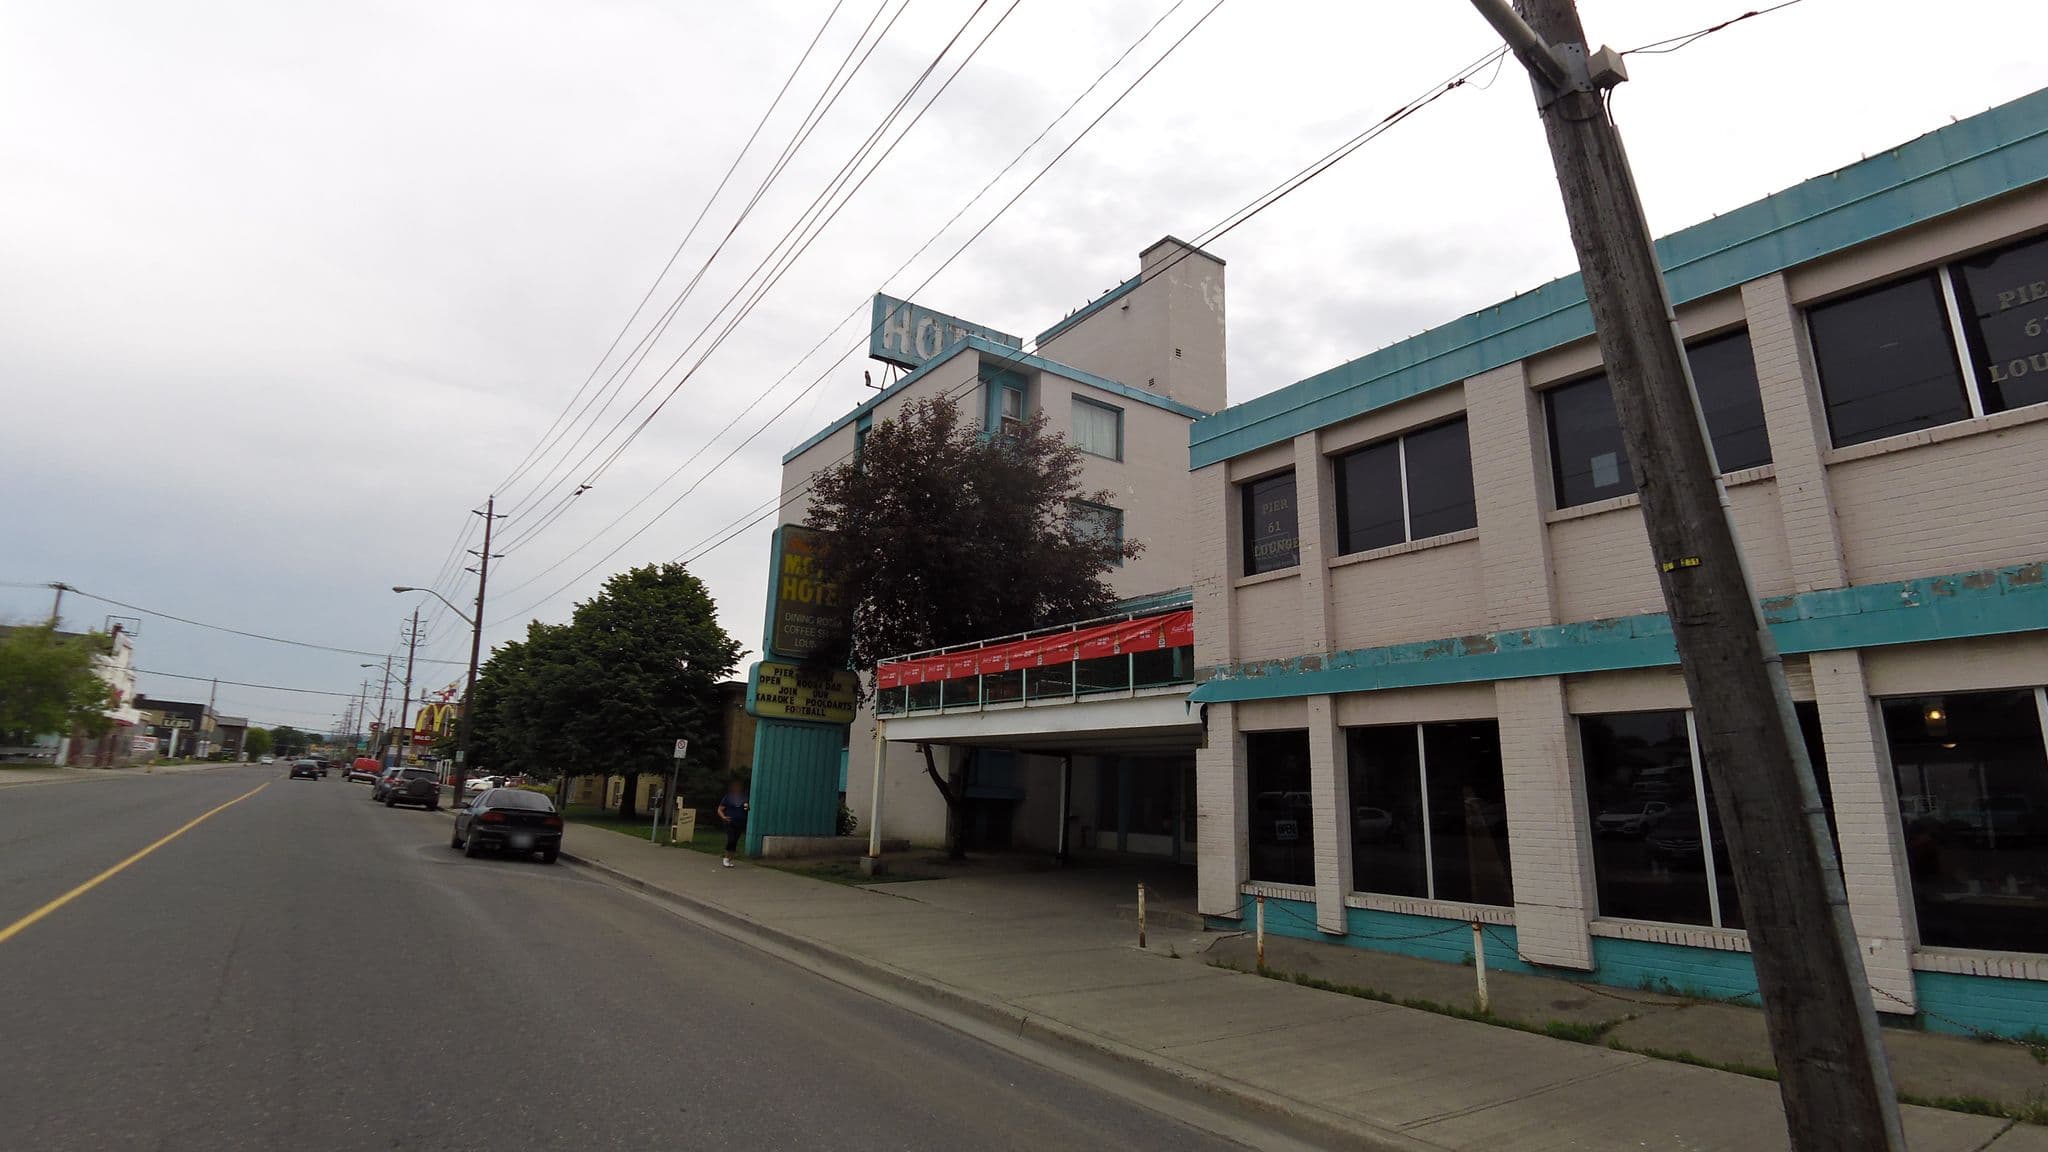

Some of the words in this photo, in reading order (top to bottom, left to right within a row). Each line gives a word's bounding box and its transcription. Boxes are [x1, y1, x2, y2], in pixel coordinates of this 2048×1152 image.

[883, 303, 1008, 361] HOT
[2024, 314, 2048, 337] 6
[1263, 497, 1289, 513] PIER
[1267, 520, 1281, 534] 61
[1254, 536, 1300, 558] LOUNGE
[782, 576, 841, 608] HOTE
[784, 612, 816, 626] DINING
[783, 624, 816, 637] COFFEE
[774, 667, 794, 678] PIER
[759, 676, 781, 685] OPEN
[757, 693, 794, 705] KARAOKE
[778, 687, 797, 695] JOIN
[813, 690, 829, 699] OUR
[785, 705, 826, 717] FOOTBALL
